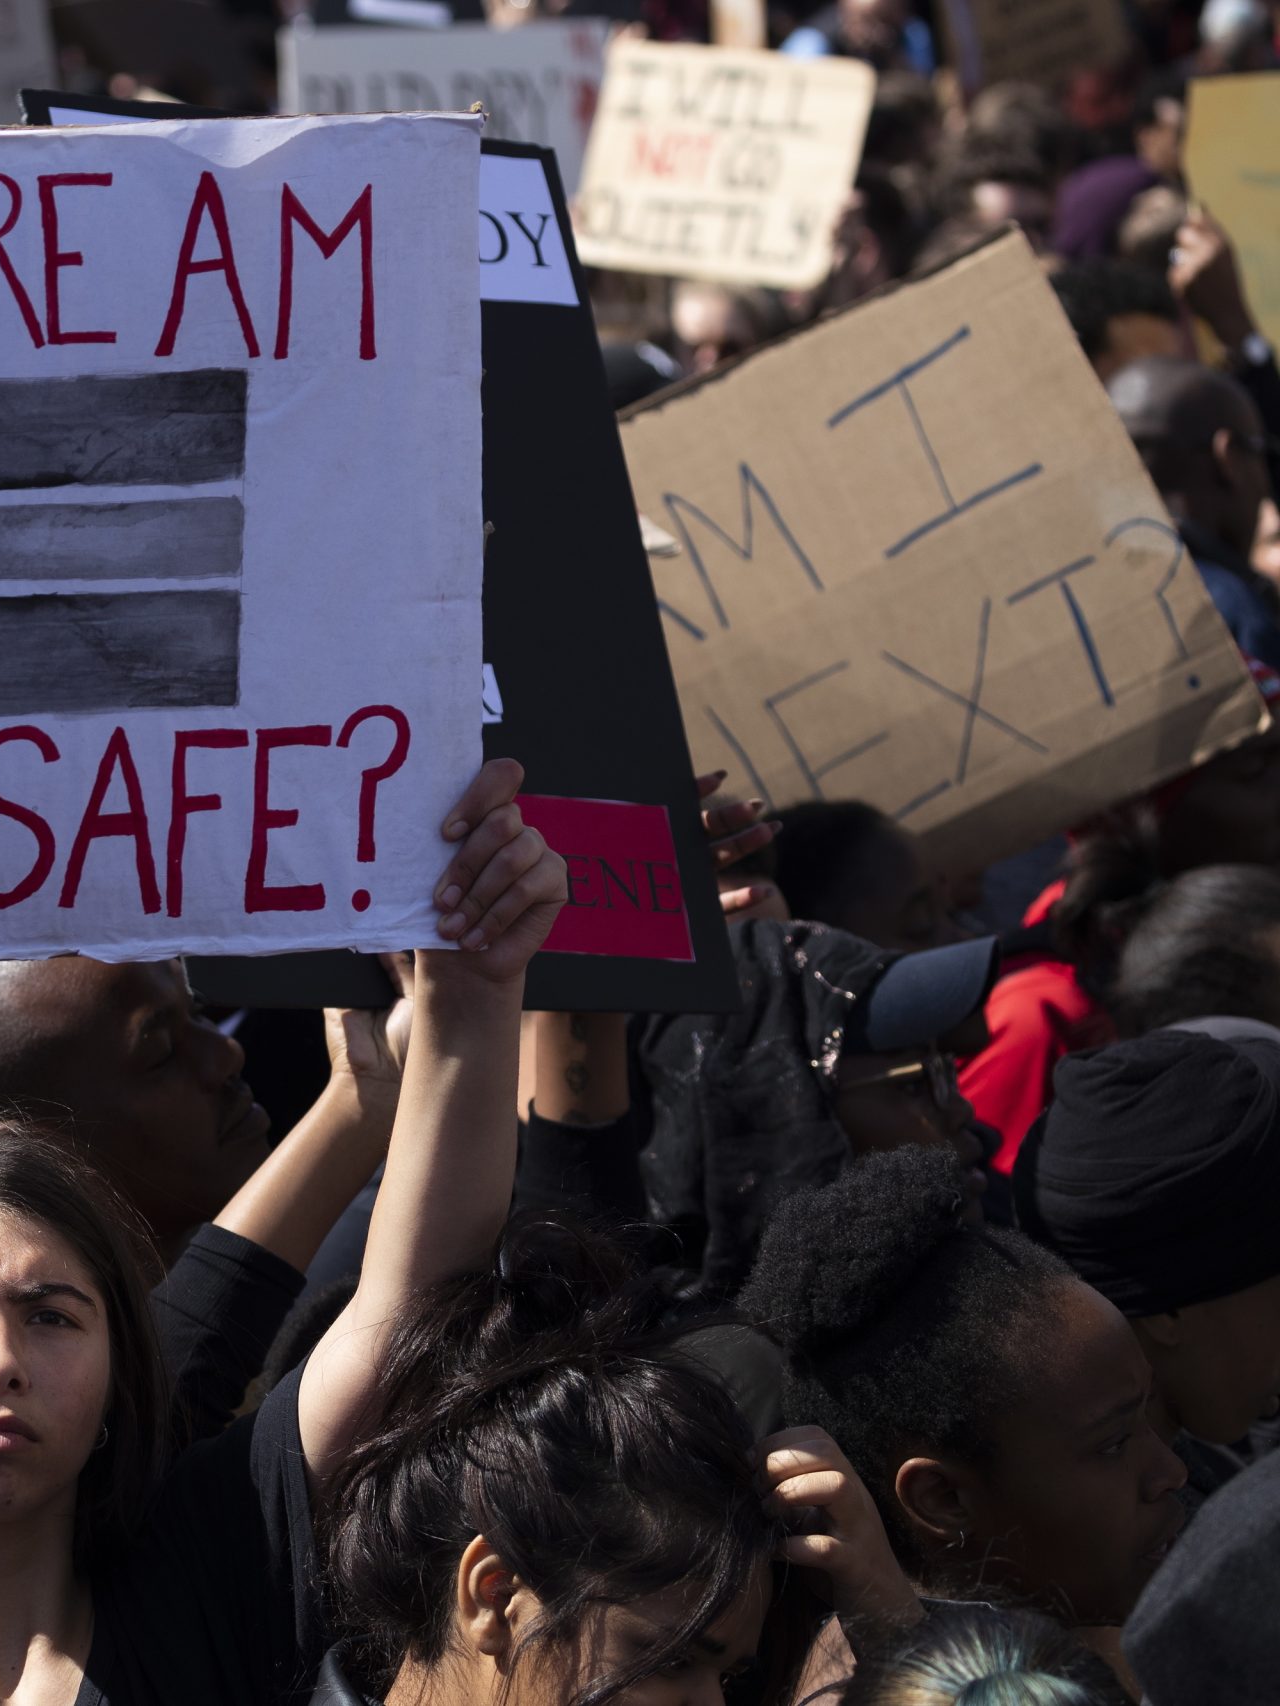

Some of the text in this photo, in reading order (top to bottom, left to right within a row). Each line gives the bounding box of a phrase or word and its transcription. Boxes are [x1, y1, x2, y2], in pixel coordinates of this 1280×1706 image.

[629, 131, 718, 182] NOT
[155, 171, 376, 360] AM
[827, 325, 1044, 558] I
